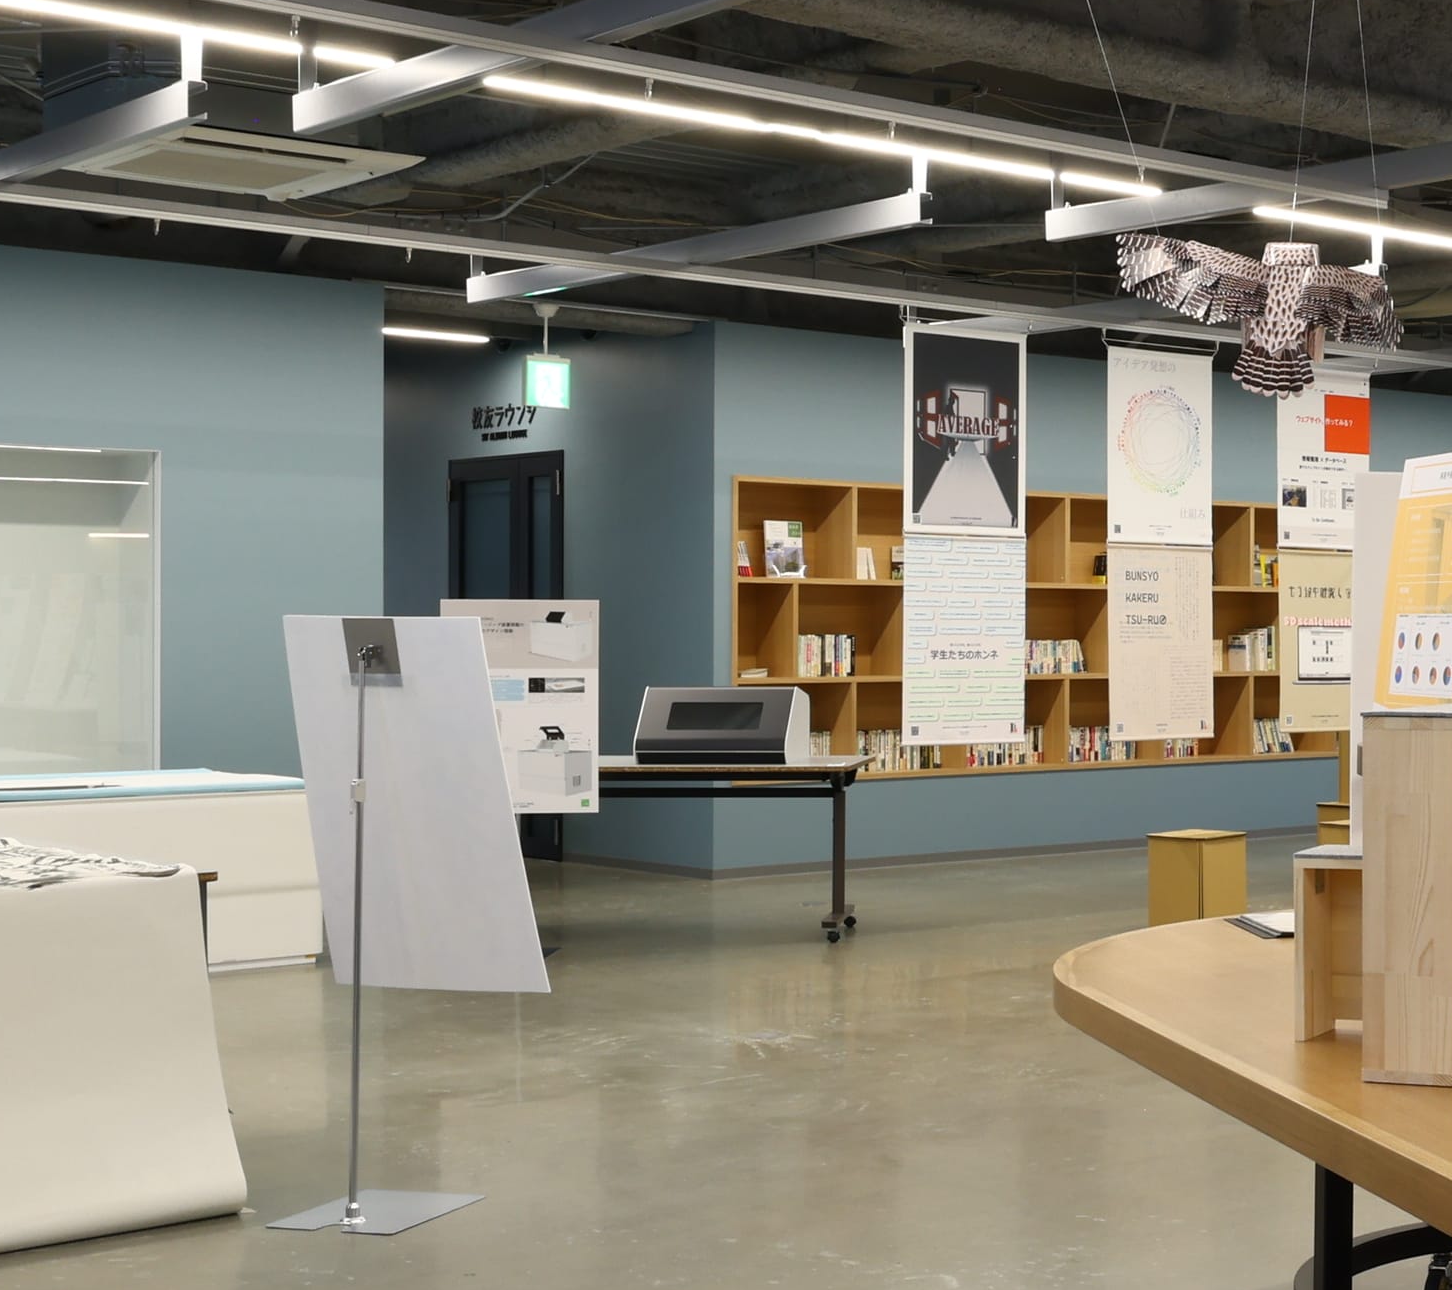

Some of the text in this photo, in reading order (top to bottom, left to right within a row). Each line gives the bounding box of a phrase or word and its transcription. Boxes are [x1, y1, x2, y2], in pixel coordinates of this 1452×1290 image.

[937, 414, 999, 437] AVERAGE
[1125, 571, 1159, 581] BUNSYO
[1125, 593, 1159, 603] KAKERU
[930, 650, 999, 660] 学生たちのホンネ
